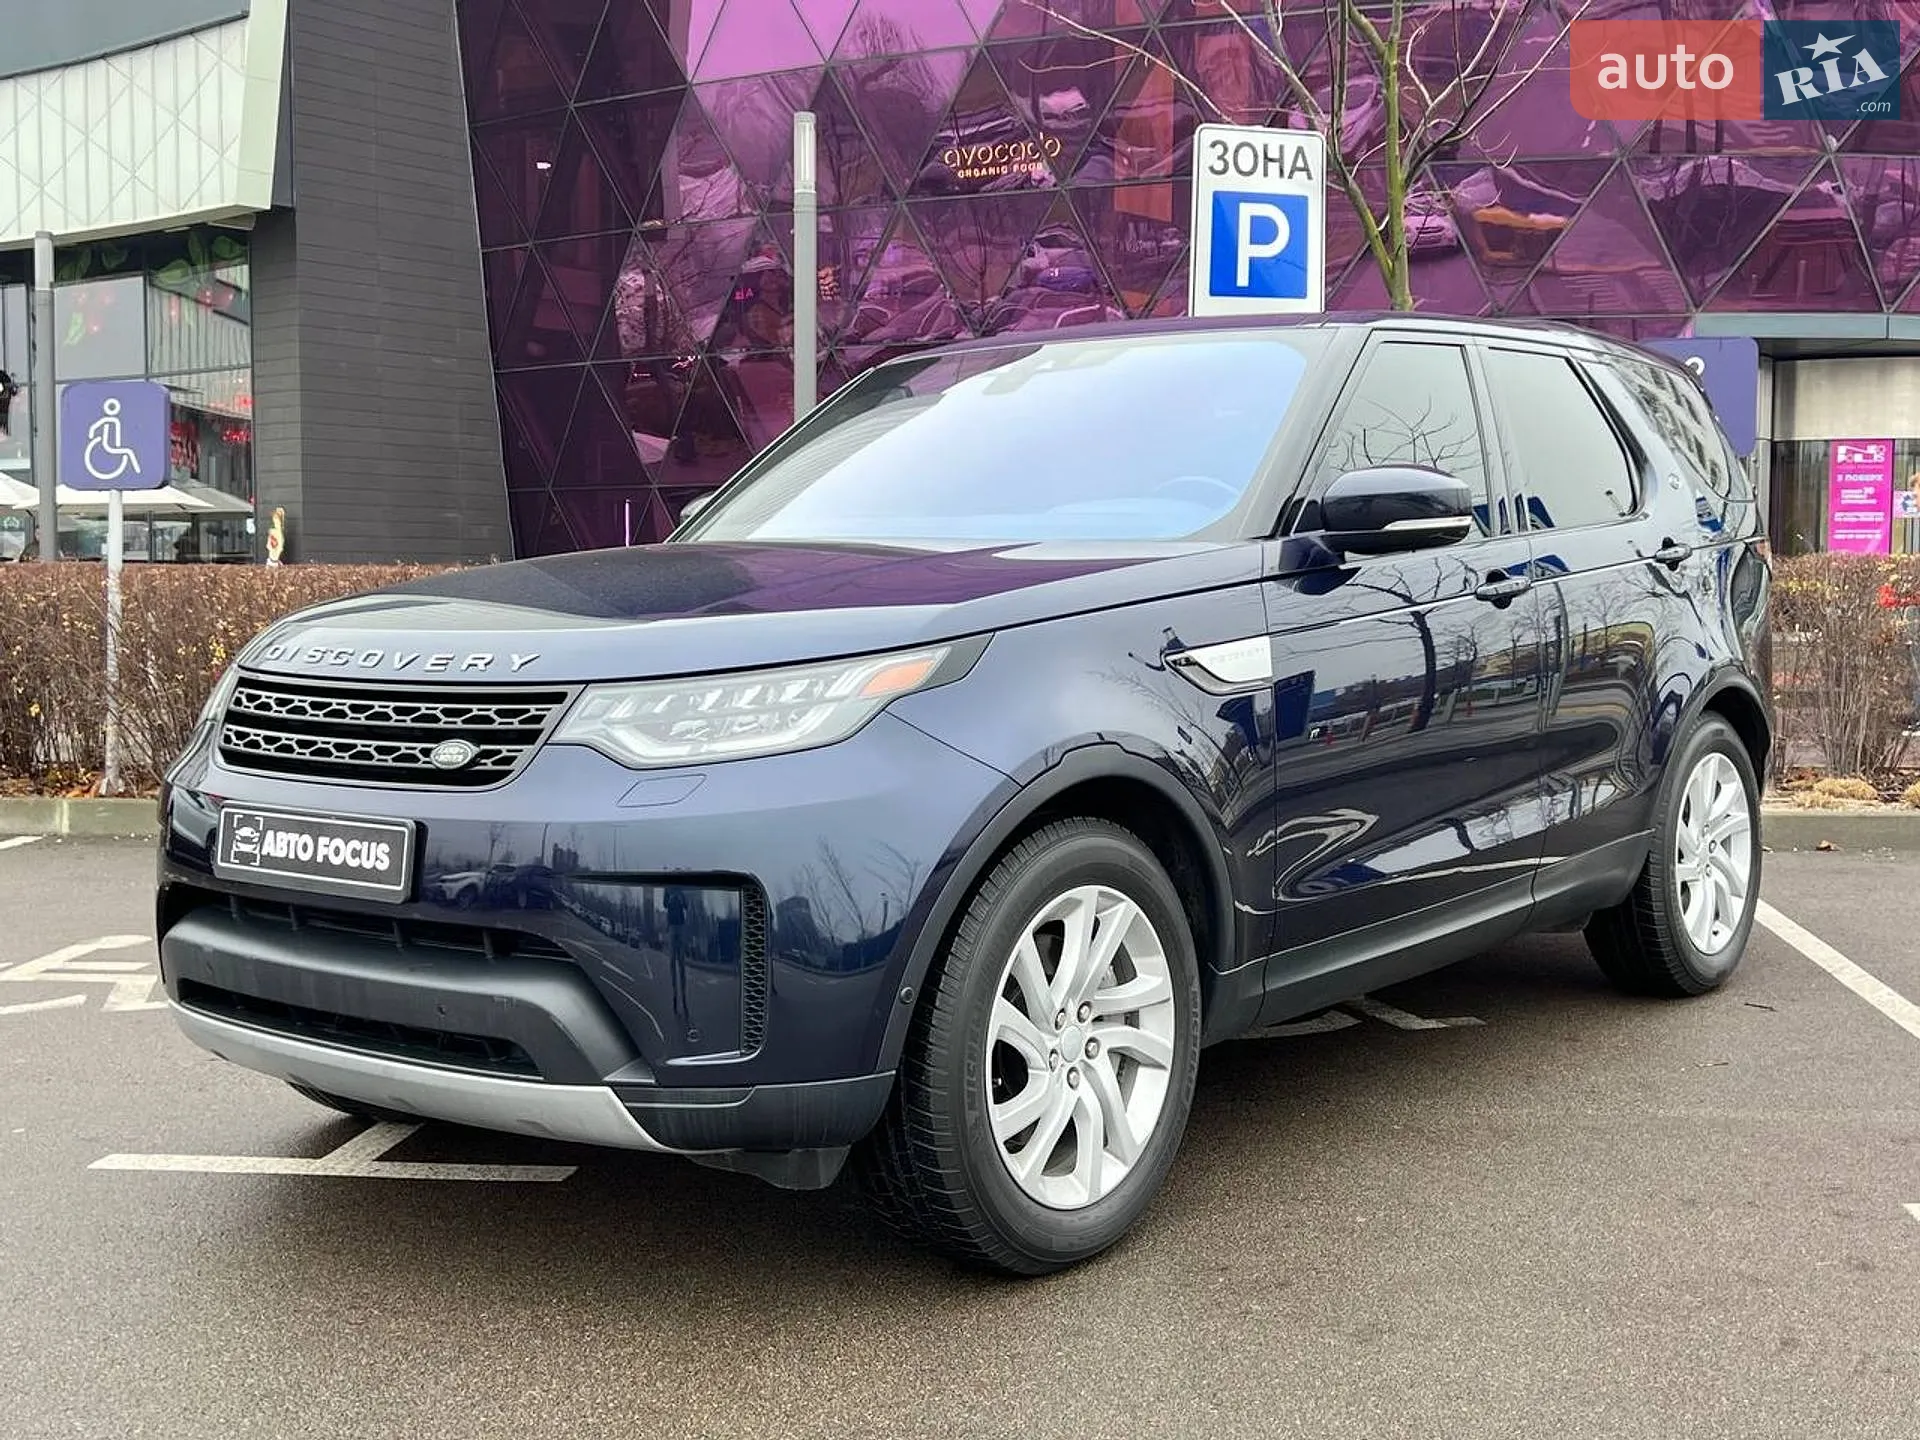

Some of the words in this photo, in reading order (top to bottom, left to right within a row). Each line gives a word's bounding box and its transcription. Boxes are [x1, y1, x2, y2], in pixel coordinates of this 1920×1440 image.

[1208, 139, 1313, 181] ЗОНА
[1236, 202, 1290, 288] P
[264, 643, 542, 673] DISCOVERY
[316, 836, 391, 871] FOCUS
